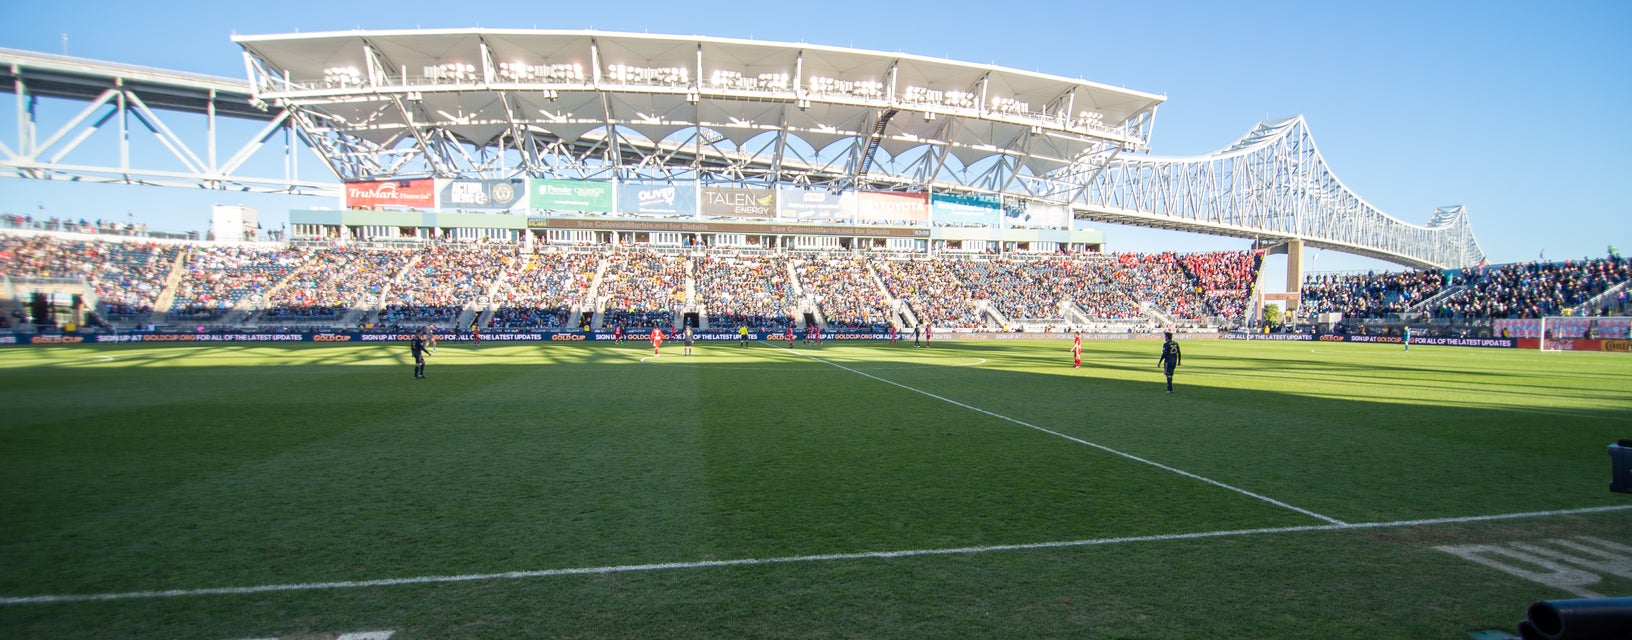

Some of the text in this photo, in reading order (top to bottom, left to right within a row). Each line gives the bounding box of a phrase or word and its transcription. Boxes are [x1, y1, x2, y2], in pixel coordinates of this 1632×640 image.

[452, 182, 482, 193] ACTION
[349, 187, 430, 201] TruMark Financial
[451, 192, 475, 203] NEWS
[638, 187, 676, 203] OLIVER
[706, 191, 756, 206] TALEN
[735, 206, 770, 214] ENERGY
[881, 202, 925, 212] TOYOTA
[577, 221, 594, 229] See
[683, 223, 709, 231] Details
[771, 225, 786, 233] See
[866, 228, 891, 236] Details
[1458, 338, 1482, 346] LATEST
[1481, 339, 1512, 347] UPDATES
